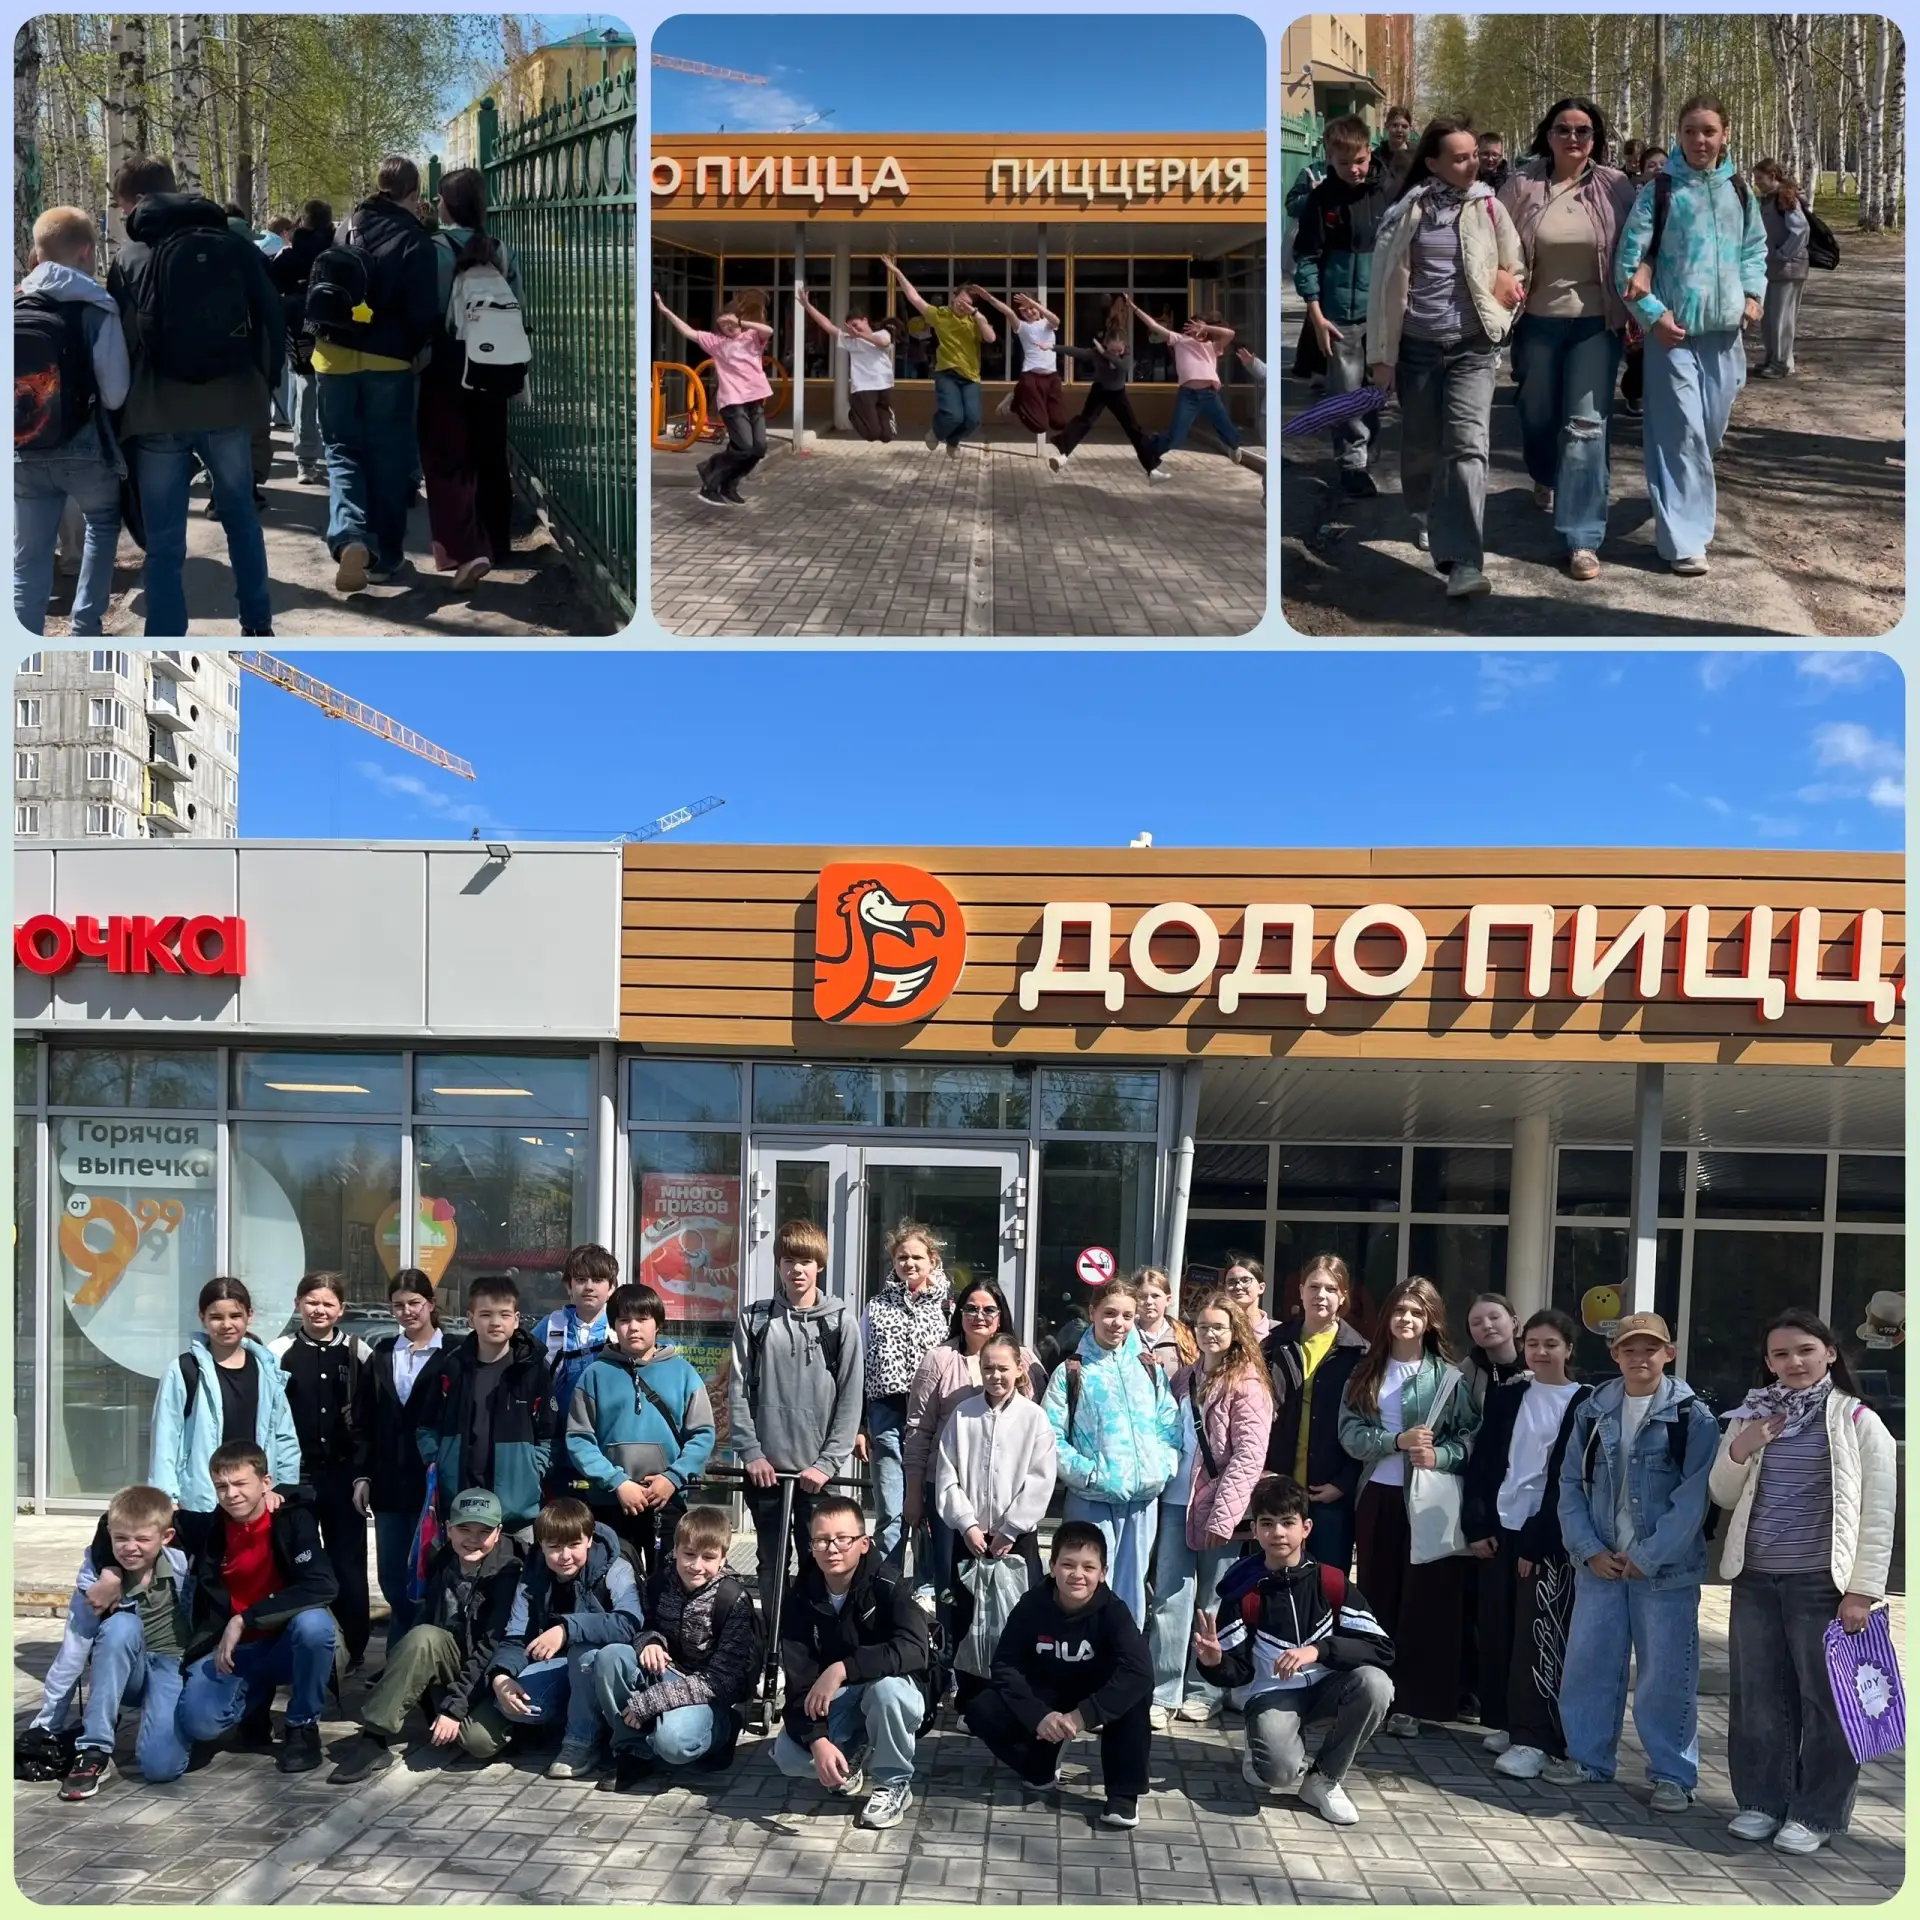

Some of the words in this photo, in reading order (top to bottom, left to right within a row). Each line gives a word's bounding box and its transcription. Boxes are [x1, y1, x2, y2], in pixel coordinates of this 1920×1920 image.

[696, 156, 909, 203] ПИЦЦА
[992, 158, 1249, 200] ПИЦЦЕРИЯ
[14, 914, 246, 976] очка
[1019, 902, 1428, 1015] ДОДО
[1462, 903, 1905, 1024] ПИЦЦ
[77, 1120, 199, 1148] Горячая
[77, 1156, 210, 1178] выпечка
[1036, 1640, 1095, 1661] FILA
